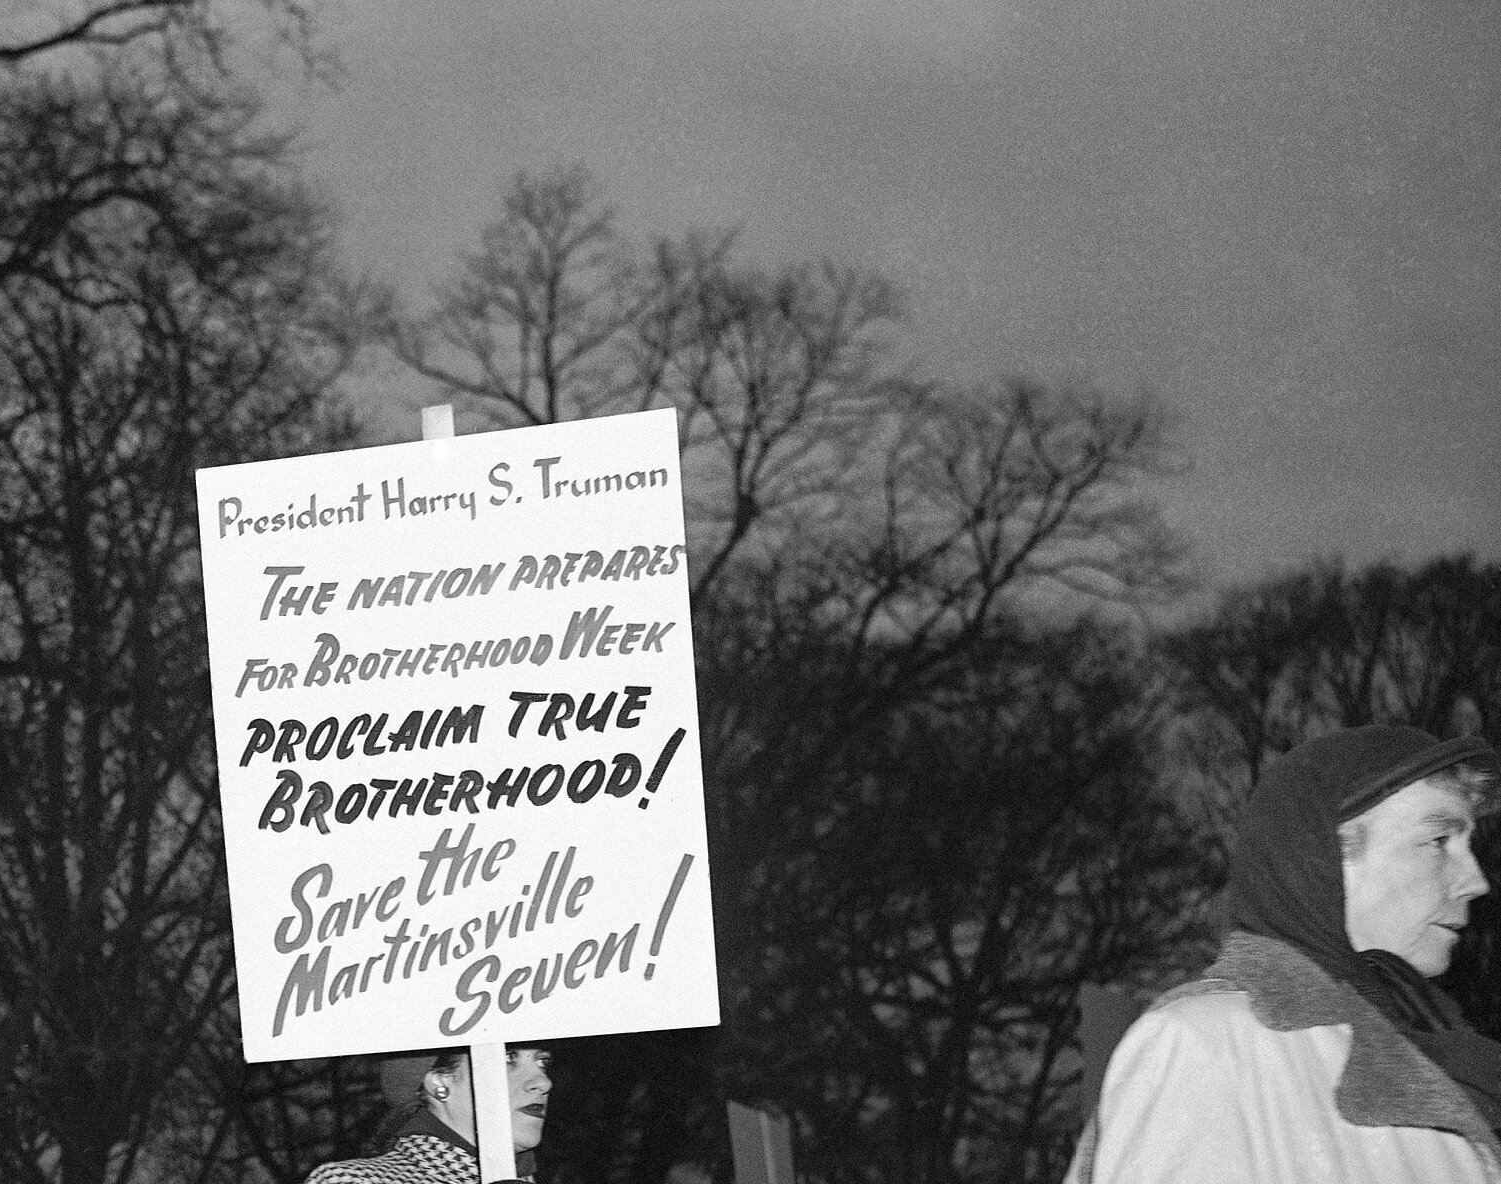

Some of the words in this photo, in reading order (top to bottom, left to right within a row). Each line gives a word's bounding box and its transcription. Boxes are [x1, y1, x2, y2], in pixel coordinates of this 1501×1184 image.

[218, 482, 372, 539] President
[381, 476, 477, 521] Harry
[488, 461, 522, 507] S.
[533, 455, 668, 500] Truman
[259, 565, 338, 620] THE
[347, 562, 506, 611] NATION
[508, 544, 686, 593] PREPARES
[235, 657, 299, 698] FOR
[303, 632, 554, 687] BROTHERHOOD
[558, 605, 676, 660] WEEK
[239, 704, 485, 767] PROCLAIM
[508, 686, 652, 740] TRUE
[258, 727, 687, 835] BROTHERHOOD!
[274, 863, 406, 954] Save
[416, 822, 516, 906] the
[271, 846, 594, 1037] Martinsville
[439, 853, 695, 1037] Seven!
